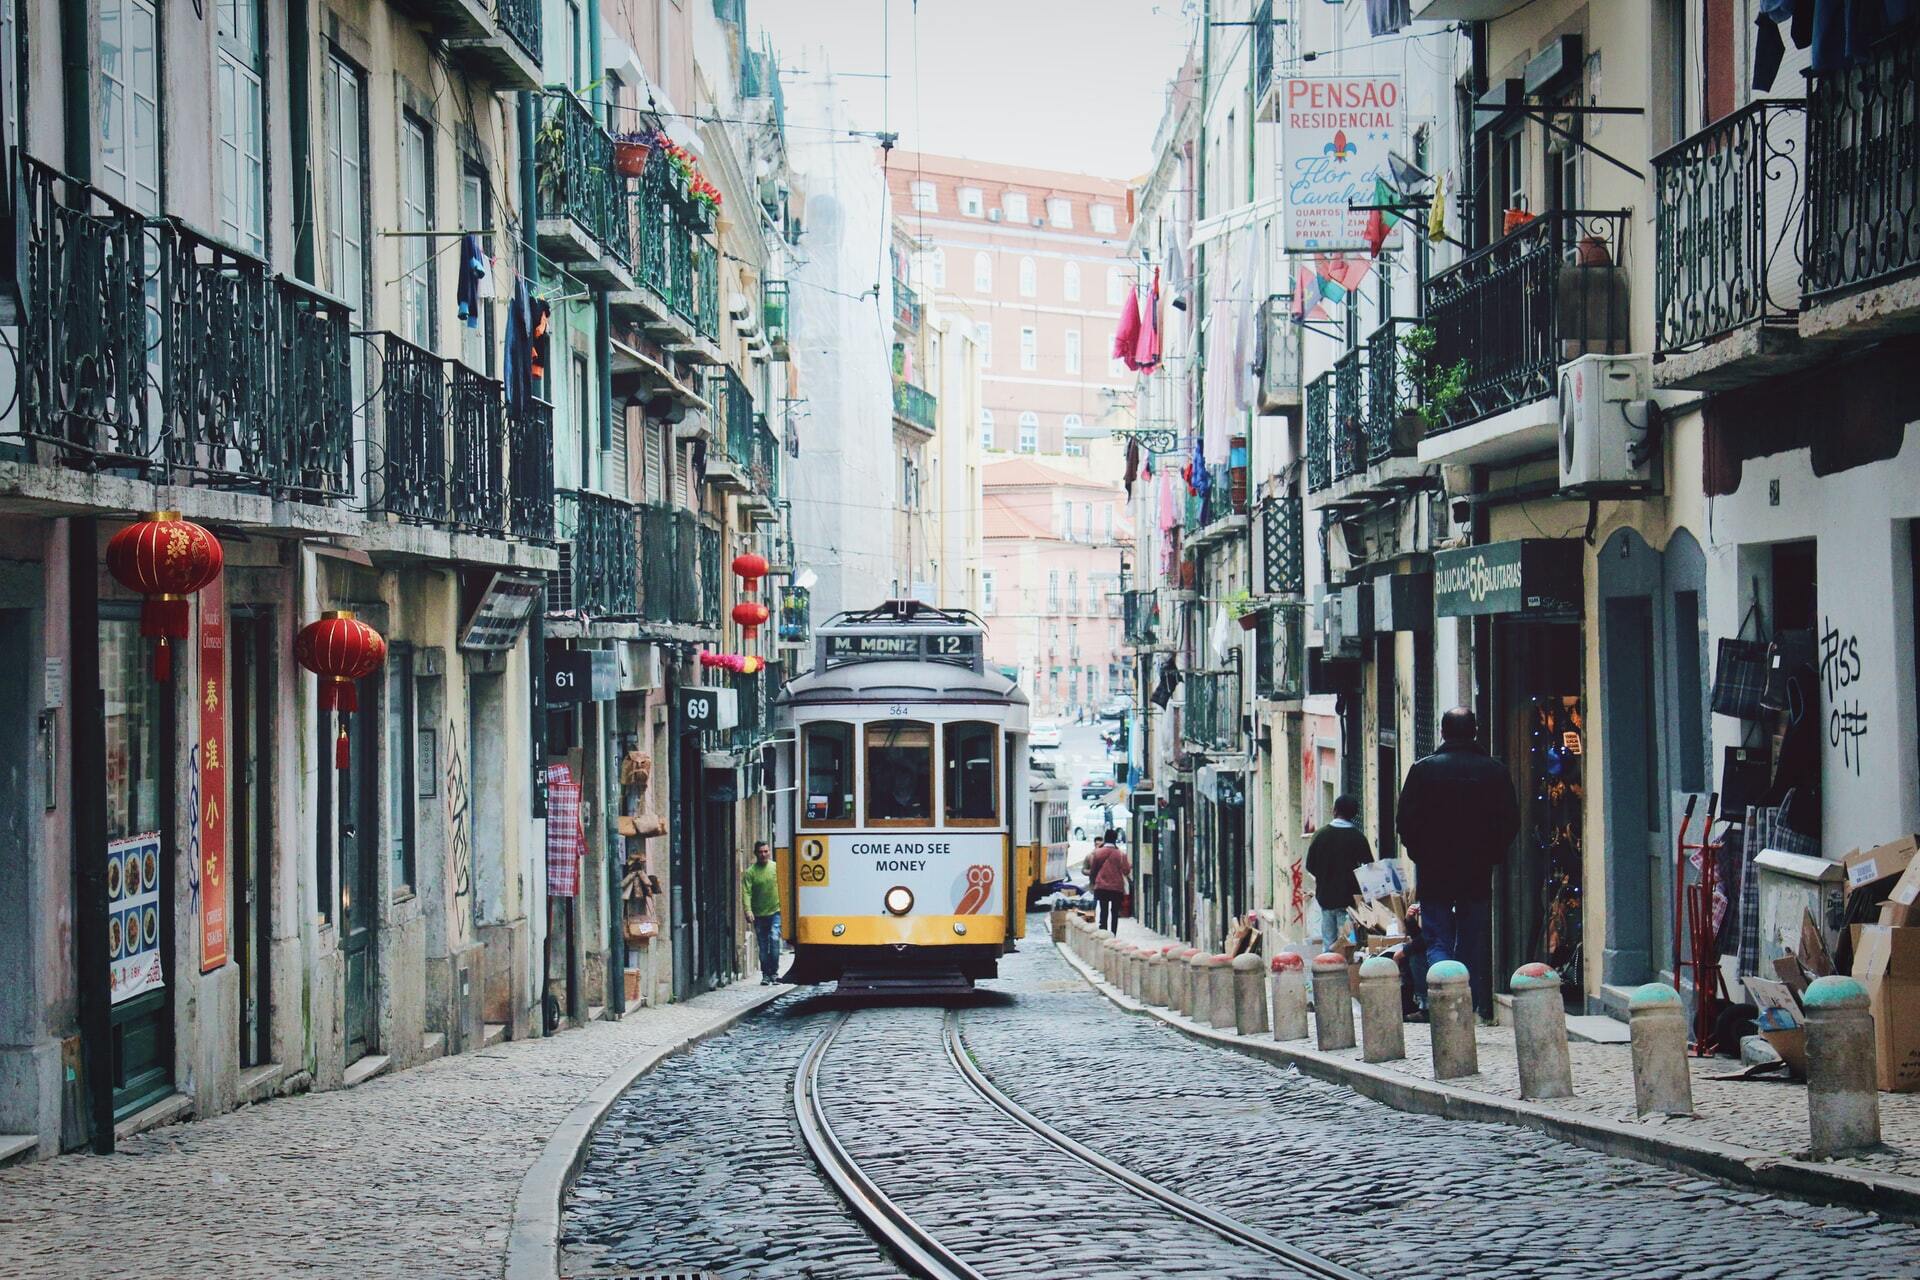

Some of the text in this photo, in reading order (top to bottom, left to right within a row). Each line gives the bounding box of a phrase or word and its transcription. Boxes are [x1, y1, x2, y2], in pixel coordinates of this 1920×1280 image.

[1290, 112, 1394, 128] RESIDENCIAL
[1295, 156, 1351, 184] Flor
[1296, 208, 1340, 217] QUARTOS
[1469, 555, 1486, 602] 56
[861, 637, 918, 652] MONIZ
[937, 636, 961, 654] 12
[555, 671, 574, 687] 61
[687, 698, 709, 719] 69
[889, 706, 908, 716] 564
[851, 843, 951, 854] COME AND SEE
[876, 860, 926, 871] MONEY
